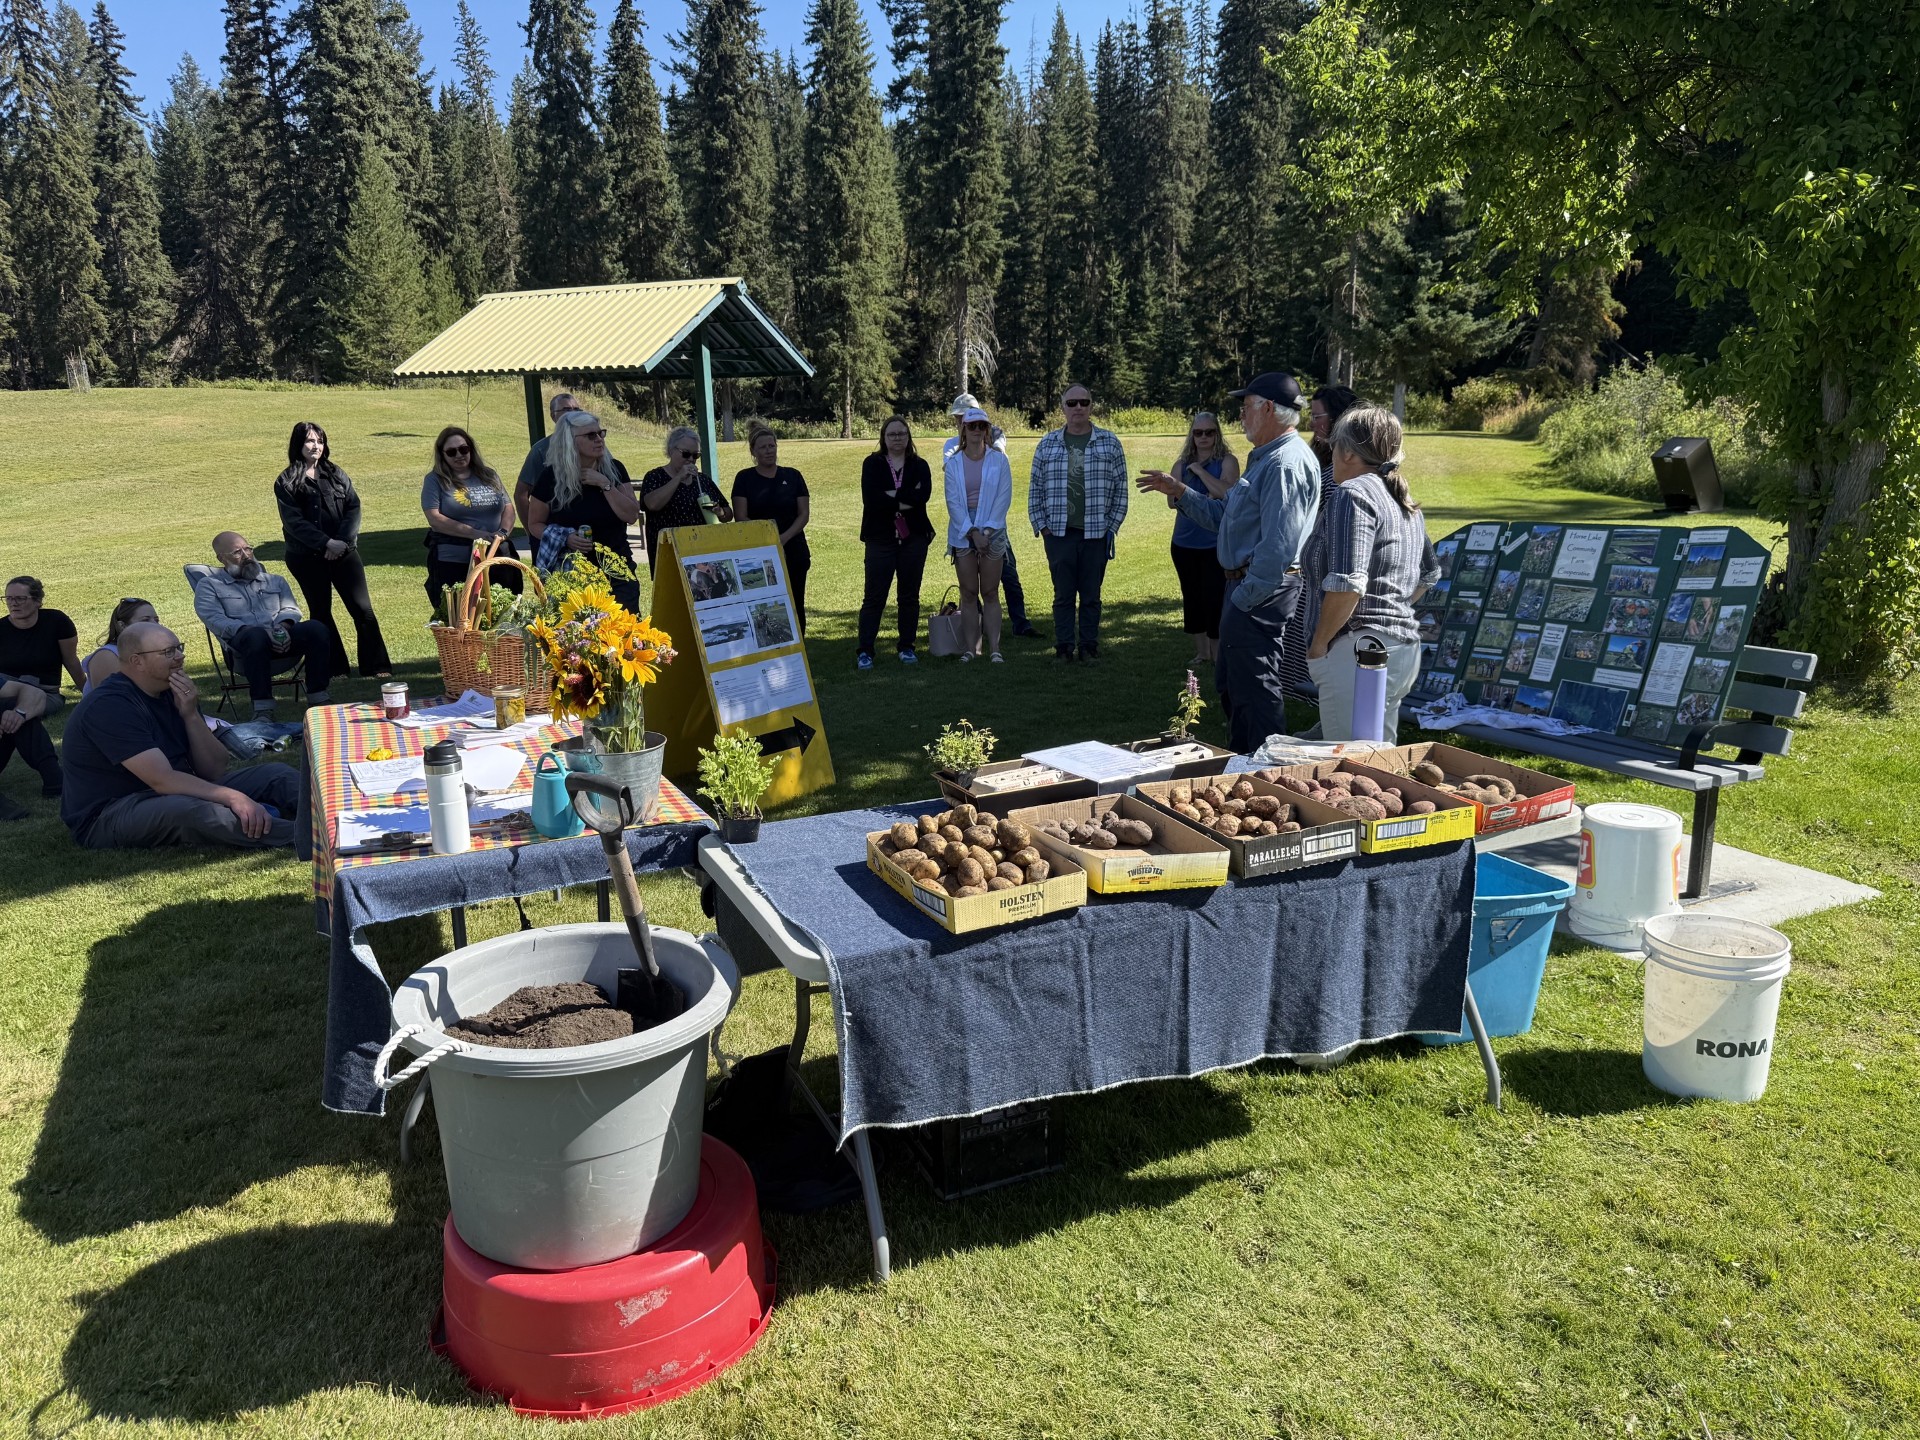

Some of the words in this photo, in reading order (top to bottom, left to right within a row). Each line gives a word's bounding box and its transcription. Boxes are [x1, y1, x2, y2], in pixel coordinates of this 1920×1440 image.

[1587, 533, 1602, 541] Lake
[1566, 543, 1597, 555] Community
[1557, 567, 1591, 577] Cooperative
[1033, 778, 1055, 787] LARGE
[1127, 867, 1152, 877] TWISTED
[1152, 867, 1163, 876] TEA
[1000, 891, 1044, 909] HOLSTEN
[1008, 902, 1037, 913] PREMIUM
[1696, 1038, 1767, 1059] RONA
